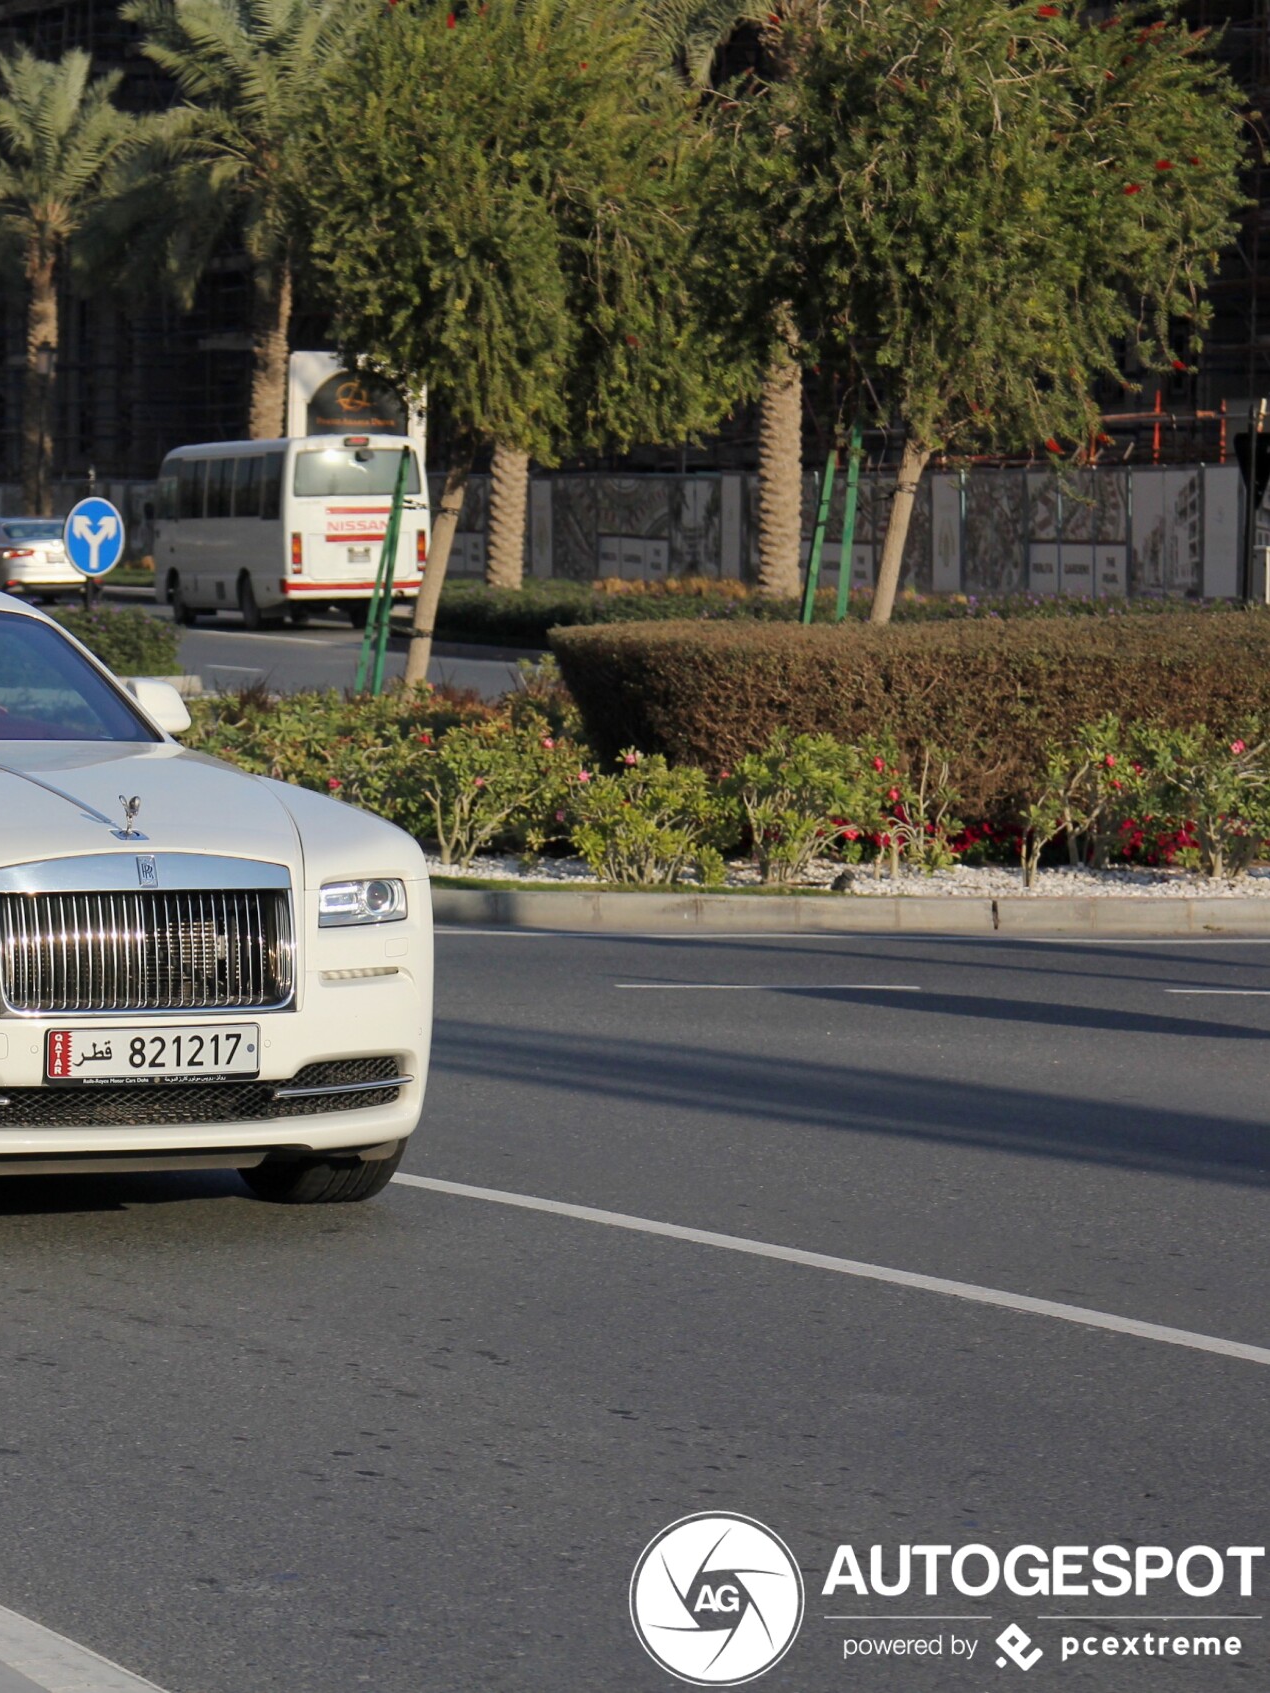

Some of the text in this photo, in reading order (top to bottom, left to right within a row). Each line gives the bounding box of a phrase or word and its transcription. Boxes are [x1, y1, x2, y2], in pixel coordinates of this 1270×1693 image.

[54, 1034, 64, 1075] QATAR
[72, 1033, 242, 1068] قطر 821217
